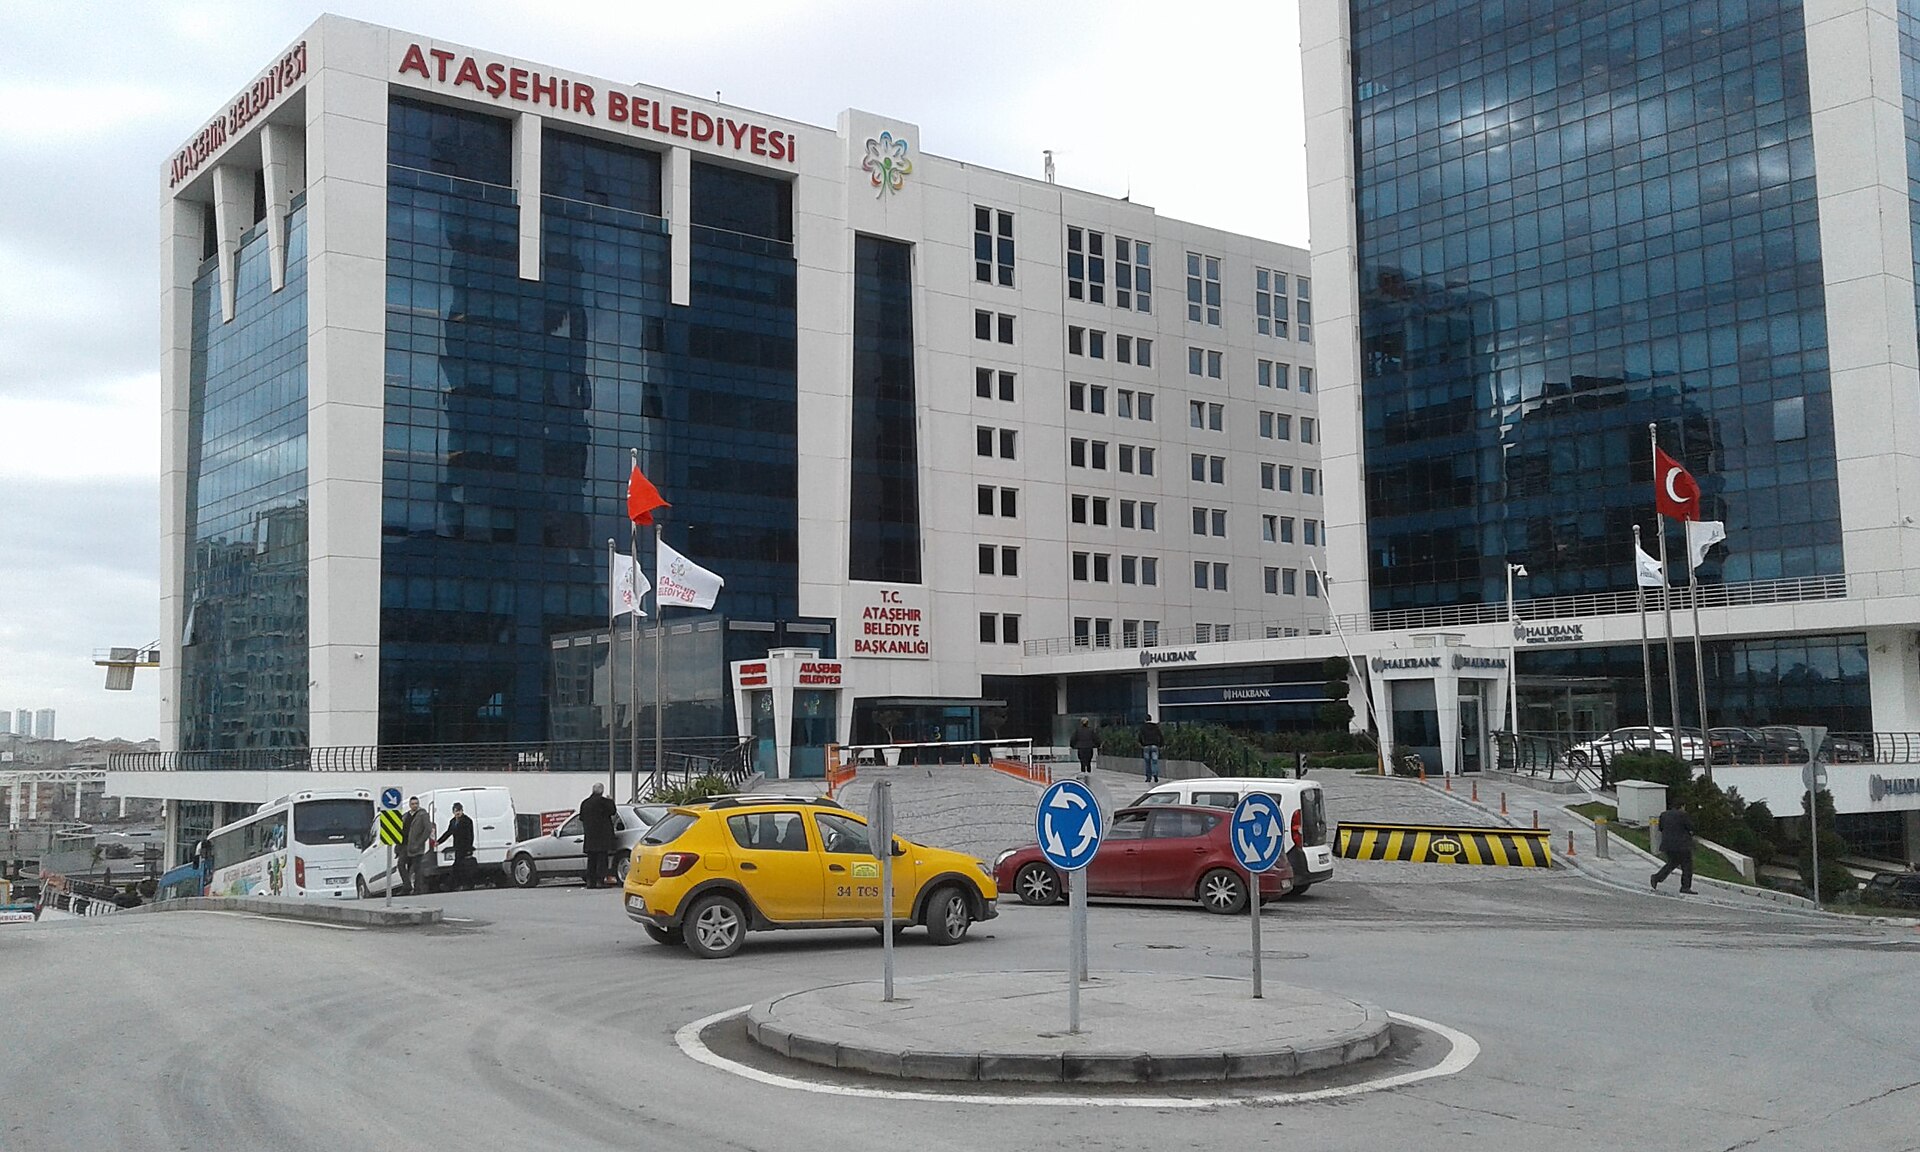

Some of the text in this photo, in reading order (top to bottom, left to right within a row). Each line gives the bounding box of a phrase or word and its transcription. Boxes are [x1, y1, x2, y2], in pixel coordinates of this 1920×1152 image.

[398, 43, 796, 163] ATAŞEHİR BELEDİYESİ
[880, 590, 902, 604] T.C.
[1526, 624, 1584, 637] HALKBANK
[854, 639, 928, 655] BAŞKANLIĞI
[1150, 650, 1197, 663] HALKBANK
[1382, 656, 1442, 670] HALKBANK
[1231, 689, 1270, 699] HALKBANK
[837, 886, 851, 897] 34
[857, 886, 879, 898] TCS
